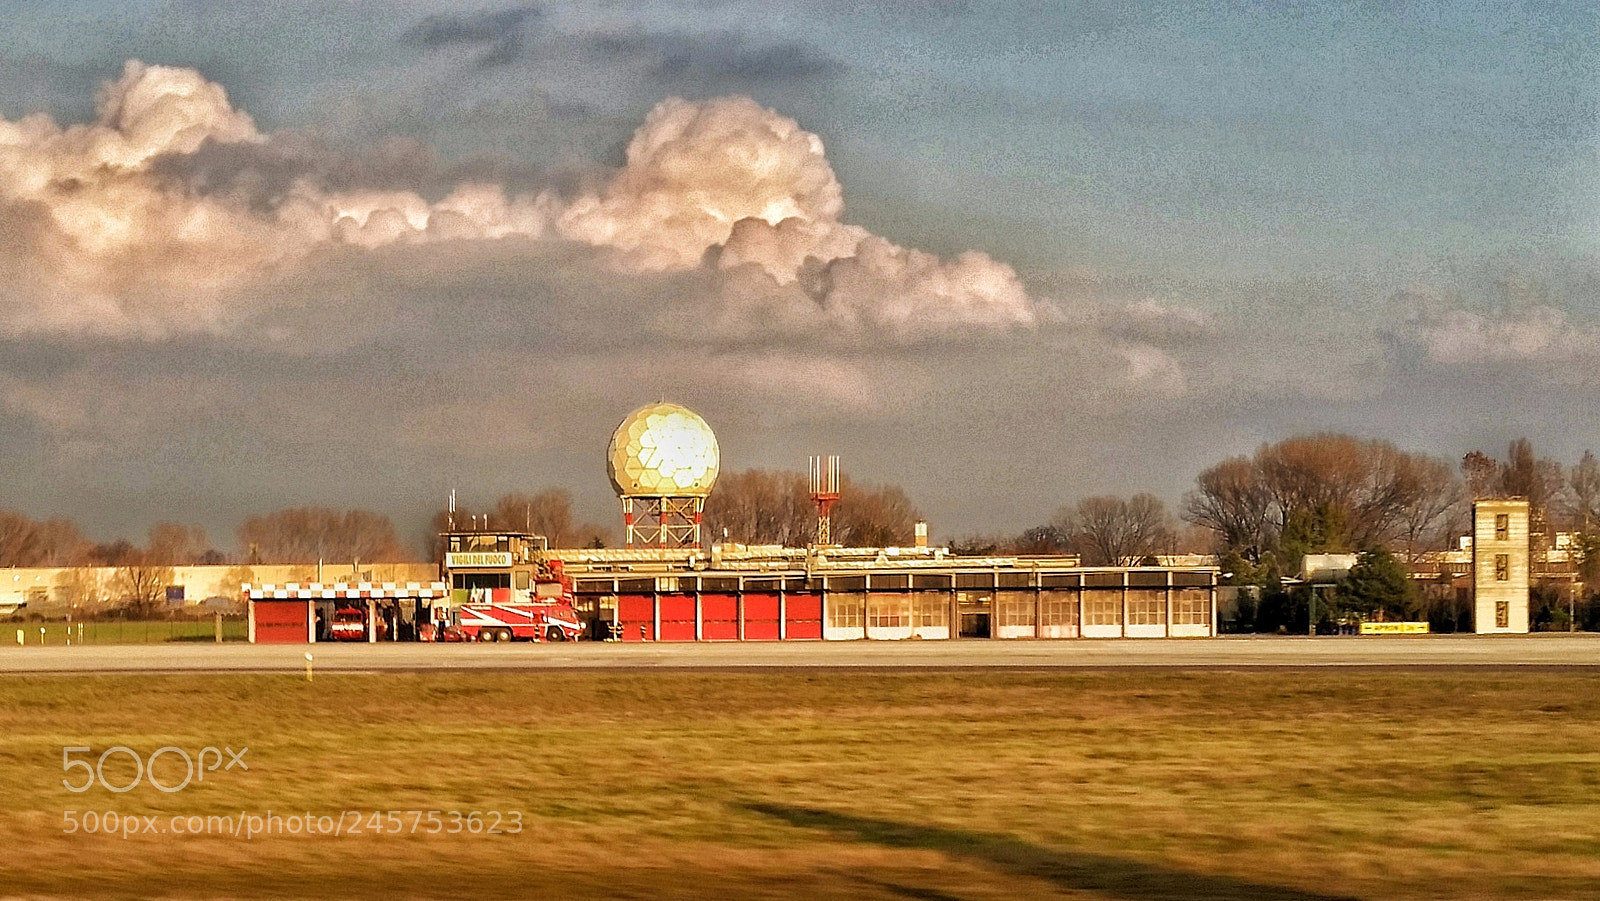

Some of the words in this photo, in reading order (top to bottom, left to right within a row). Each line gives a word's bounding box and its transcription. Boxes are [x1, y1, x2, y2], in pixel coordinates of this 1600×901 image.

[451, 554, 471, 565] VIGILI
[472, 554, 484, 565] DEL
[485, 554, 506, 565] FUOCO
